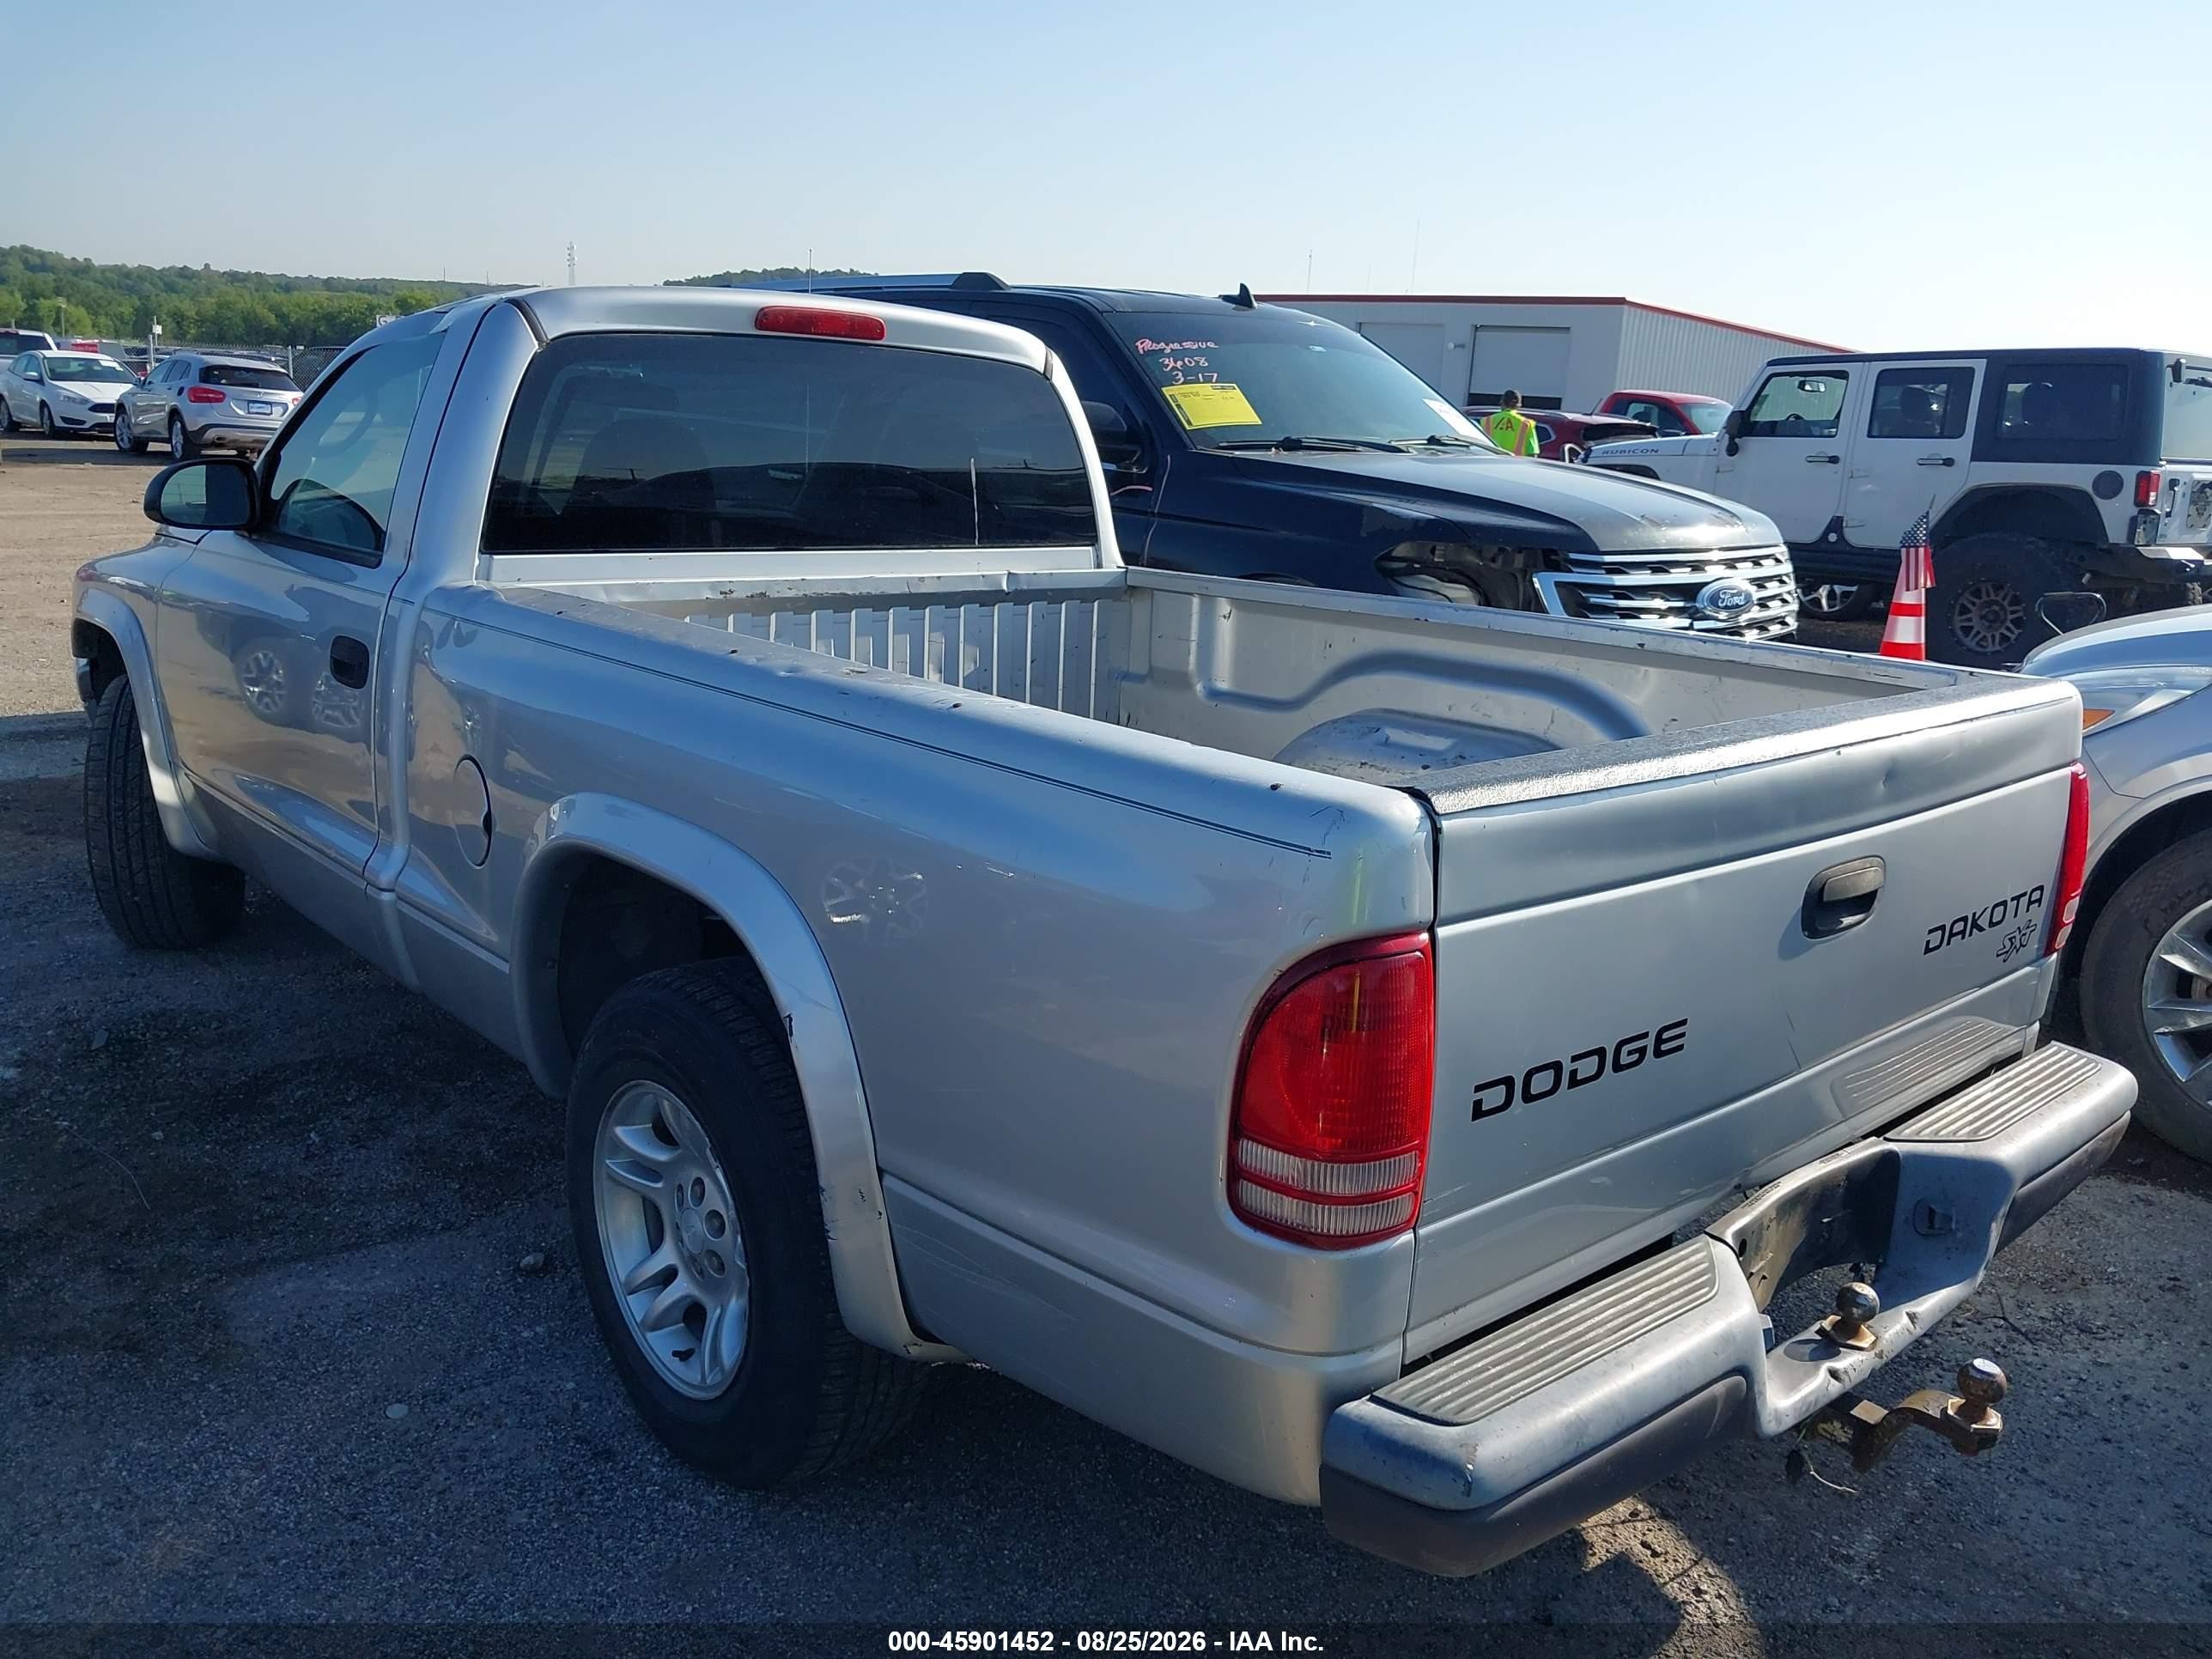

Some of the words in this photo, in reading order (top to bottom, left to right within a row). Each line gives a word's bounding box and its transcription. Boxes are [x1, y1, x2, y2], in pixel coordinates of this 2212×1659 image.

[1158, 356, 1209, 372] 3608
[1171, 371, 1218, 385] 3-17
[1718, 589, 1745, 608] Ford
[1923, 884, 2045, 956] DAKOTA
[1471, 1018, 1688, 1122] DODGE
